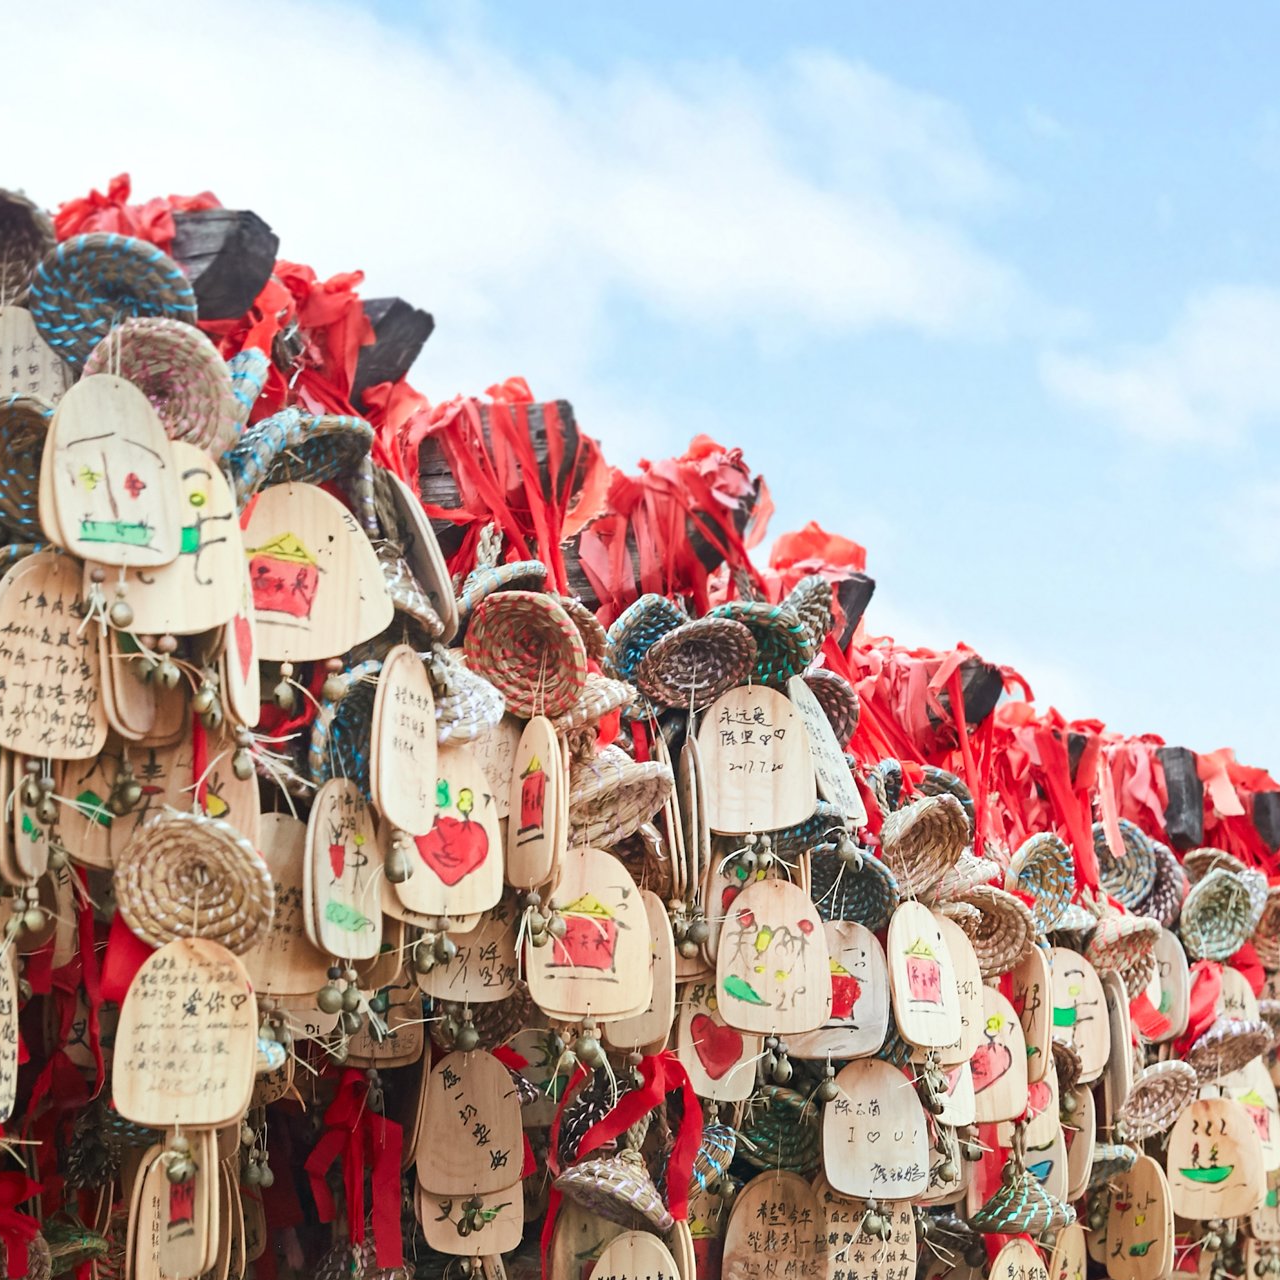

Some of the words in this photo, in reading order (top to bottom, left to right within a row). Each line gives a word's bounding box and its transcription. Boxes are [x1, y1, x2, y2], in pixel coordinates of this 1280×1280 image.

[719, 706, 773, 727] 永远爱
[756, 1200, 814, 1231] 希望今年
